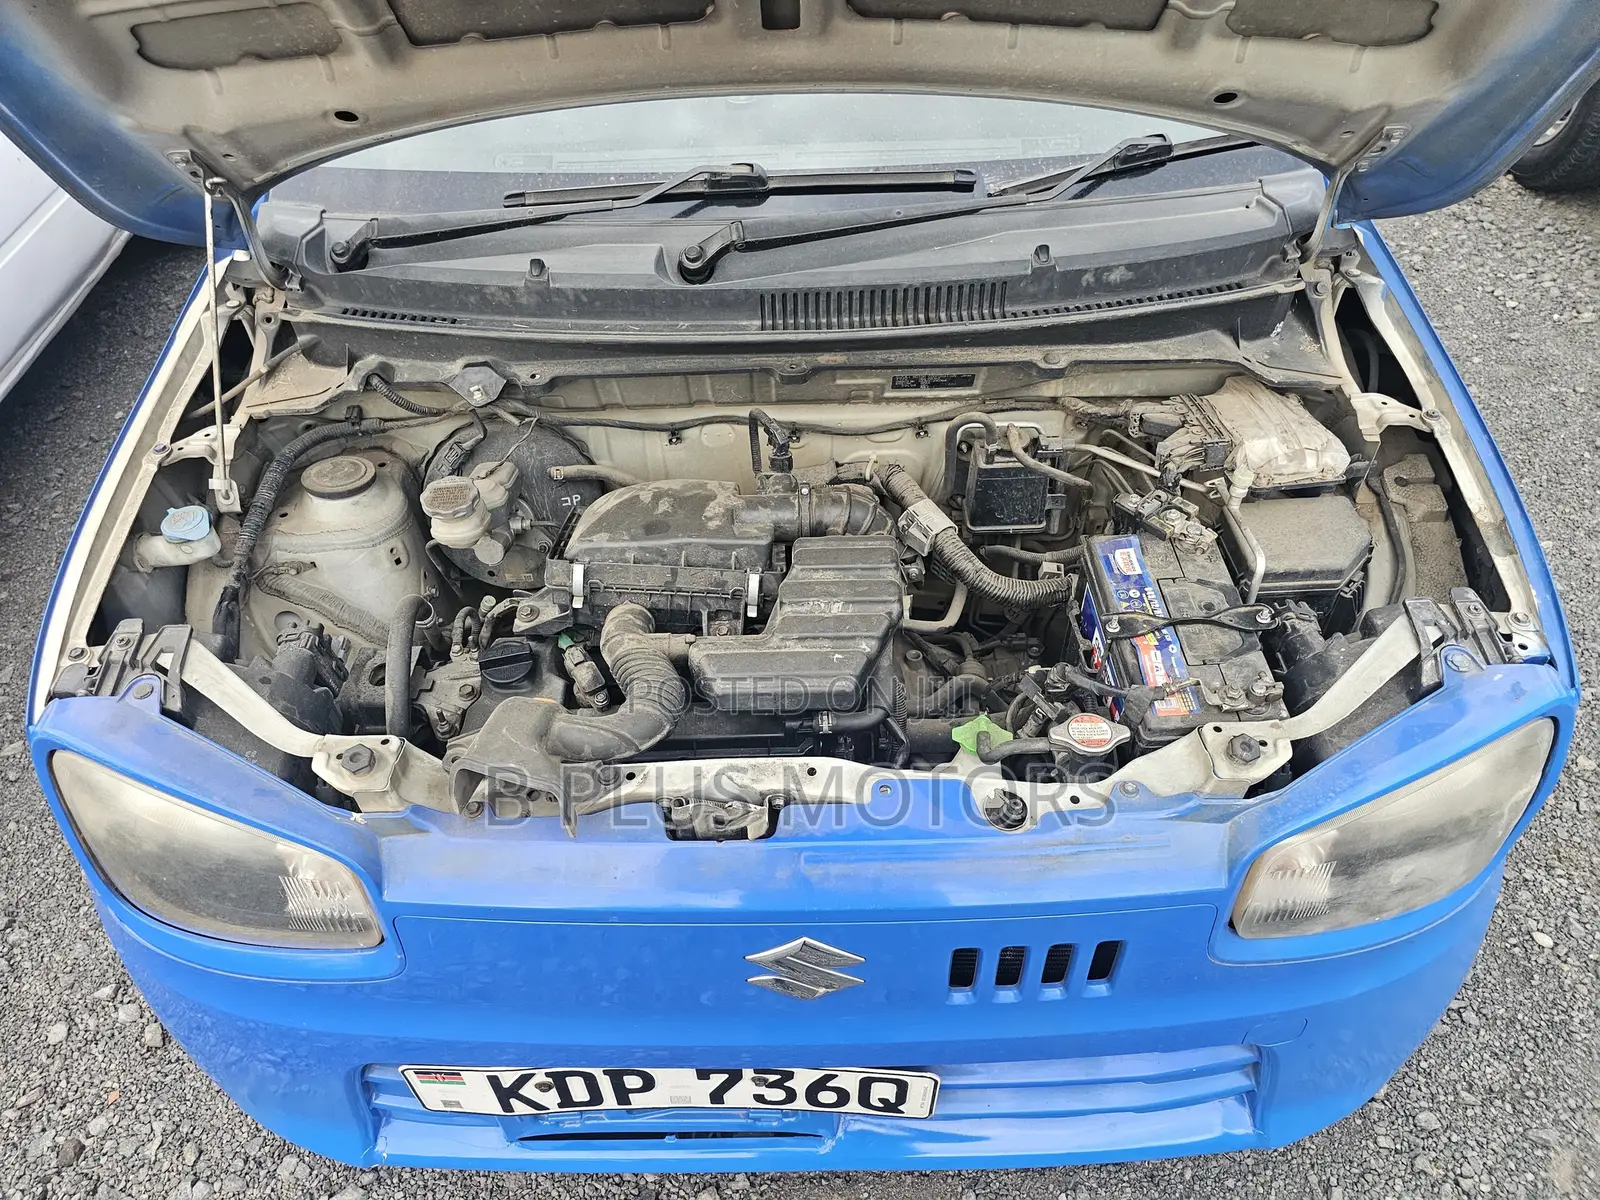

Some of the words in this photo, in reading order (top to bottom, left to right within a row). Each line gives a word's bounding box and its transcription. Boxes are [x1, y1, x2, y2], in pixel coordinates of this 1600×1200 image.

[1120, 551, 1133, 572] EXIDE
[485, 1069, 655, 1113] KDP
[696, 1068, 910, 1114] 736Q
